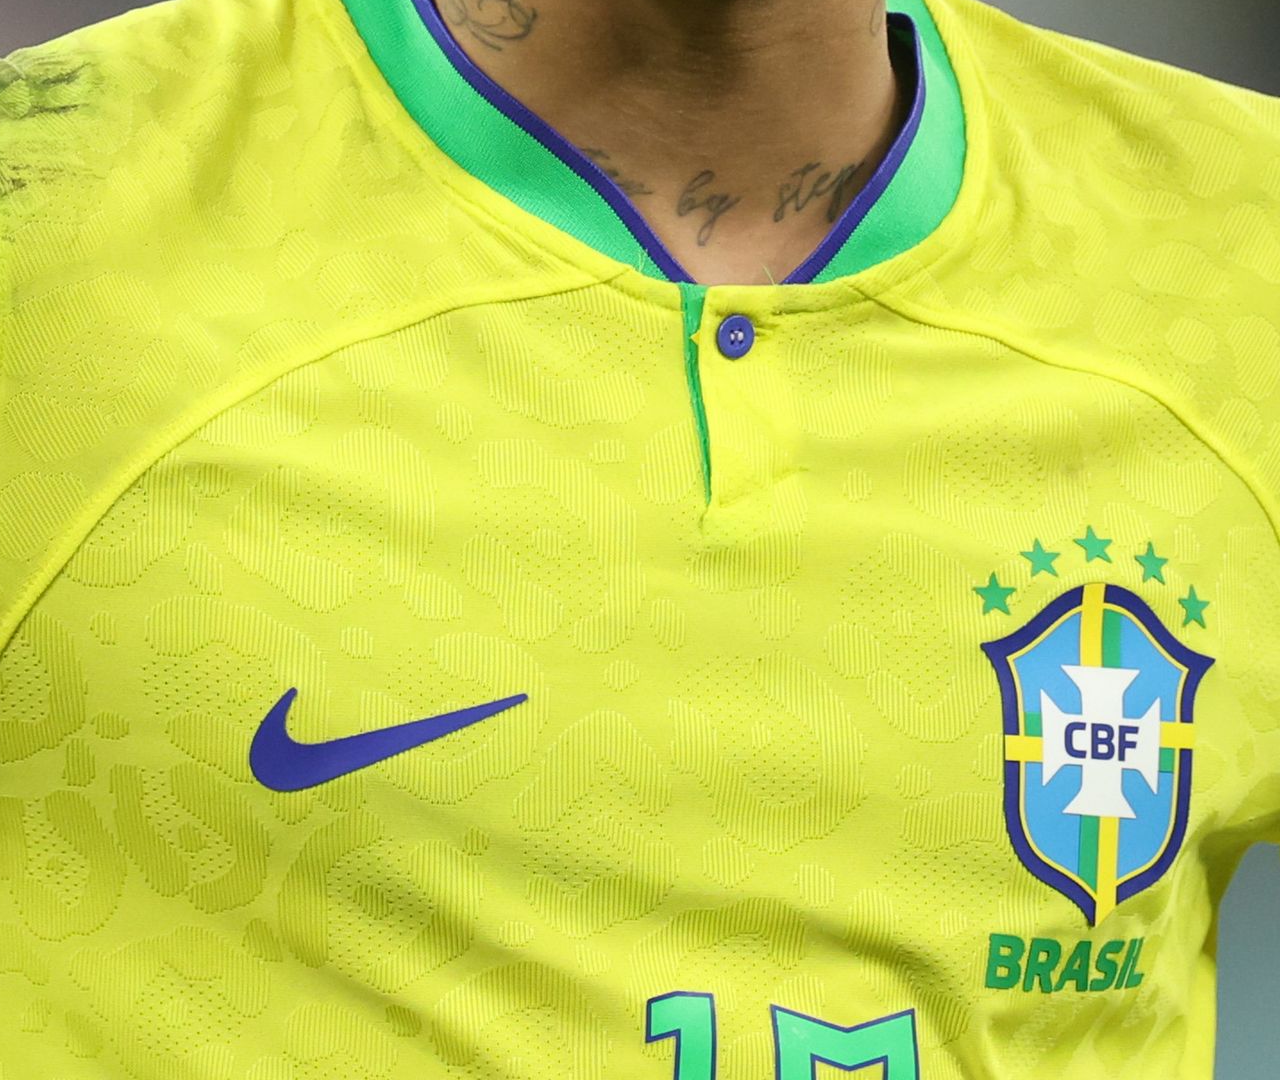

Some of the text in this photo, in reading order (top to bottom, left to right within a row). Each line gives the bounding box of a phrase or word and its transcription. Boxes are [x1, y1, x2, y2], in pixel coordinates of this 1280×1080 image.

[676, 169, 742, 246] by
[1064, 721, 1140, 762] CBF
[984, 933, 1145, 994] BRASIL
